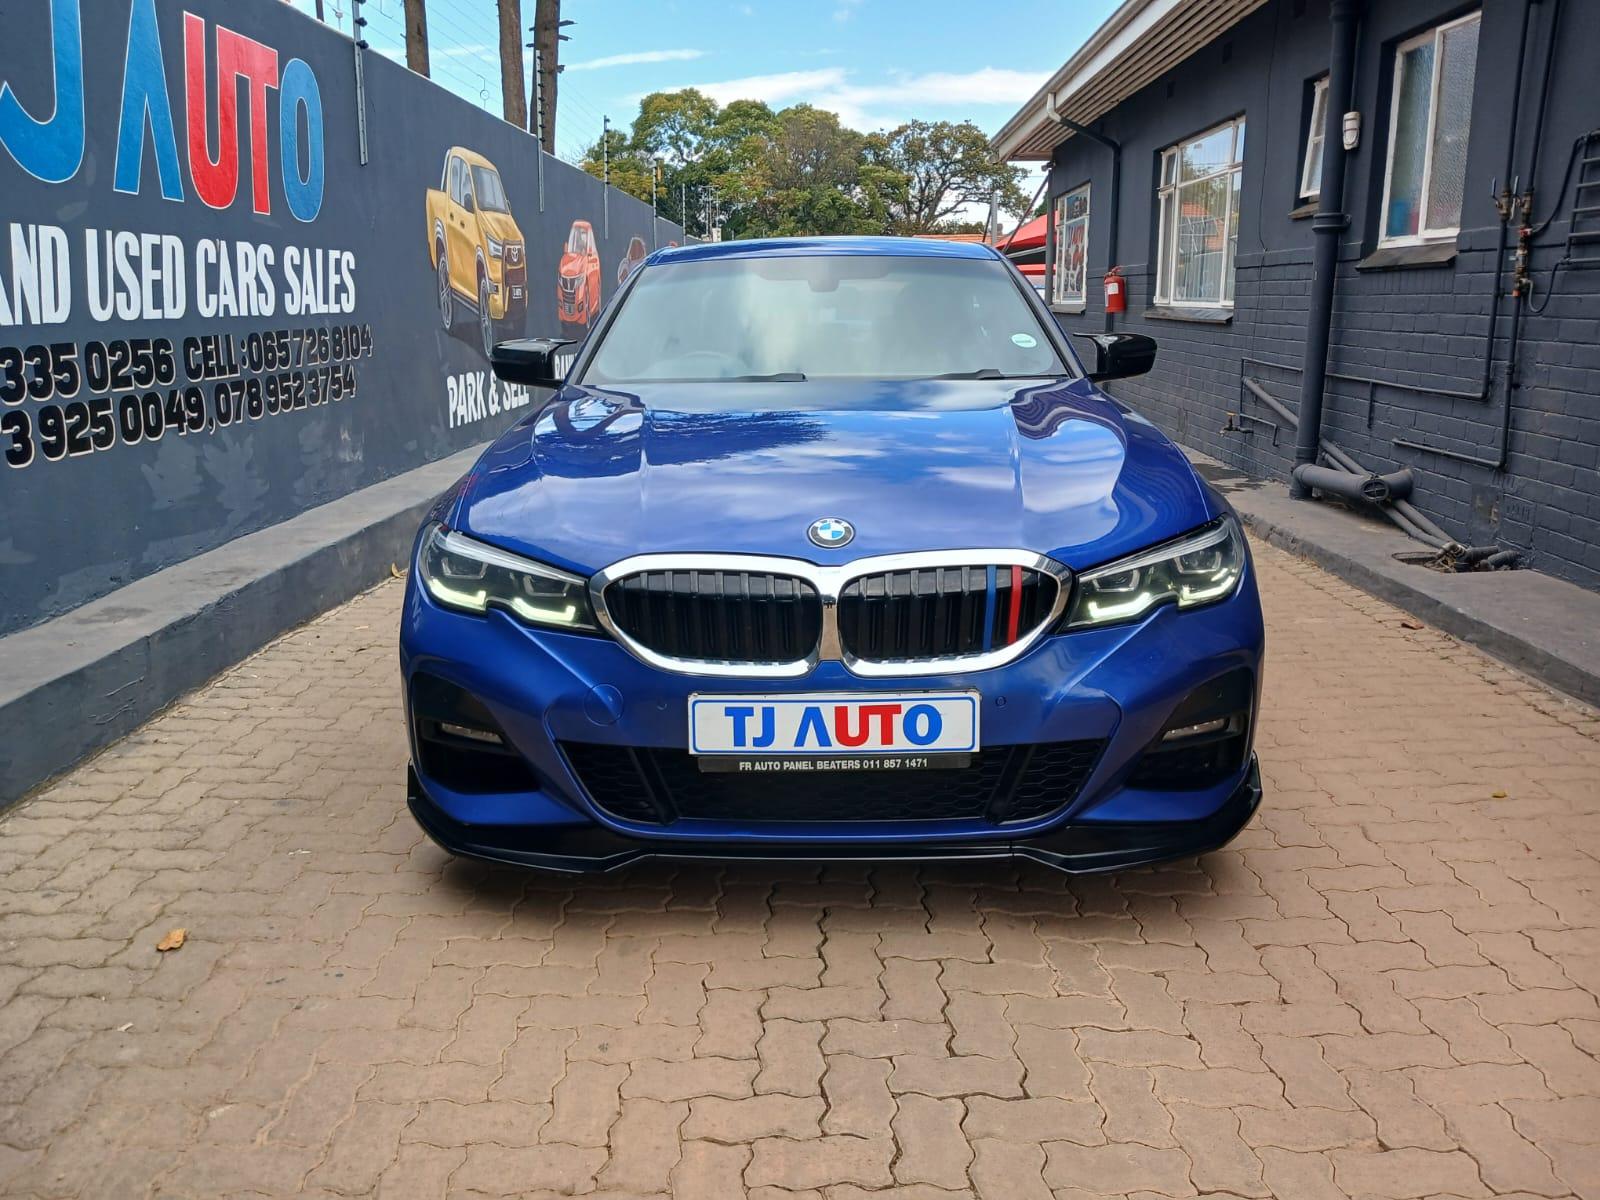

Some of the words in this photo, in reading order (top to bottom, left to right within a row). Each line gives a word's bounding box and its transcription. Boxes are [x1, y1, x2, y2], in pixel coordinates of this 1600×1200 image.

[113, 0, 325, 223] AUTO
[85, 228, 187, 322] USED
[196, 238, 276, 318] CARS
[283, 245, 356, 315] SALES
[0, 342, 82, 406] 335
[85, 338, 177, 394] 0256
[446, 371, 488, 429] PARK
[488, 369, 501, 416] &
[38, 398, 116, 462] 925
[724, 706, 775, 748] TJ
[793, 704, 943, 748] AUTO
[738, 761, 752, 771] FR
[754, 761, 781, 771] AUTO
[783, 761, 814, 771] PANEL
[816, 760, 861, 770] BEATERS
[862, 759, 880, 769] 011
[883, 759, 901, 768] 857
[904, 758, 928, 768] 1471
